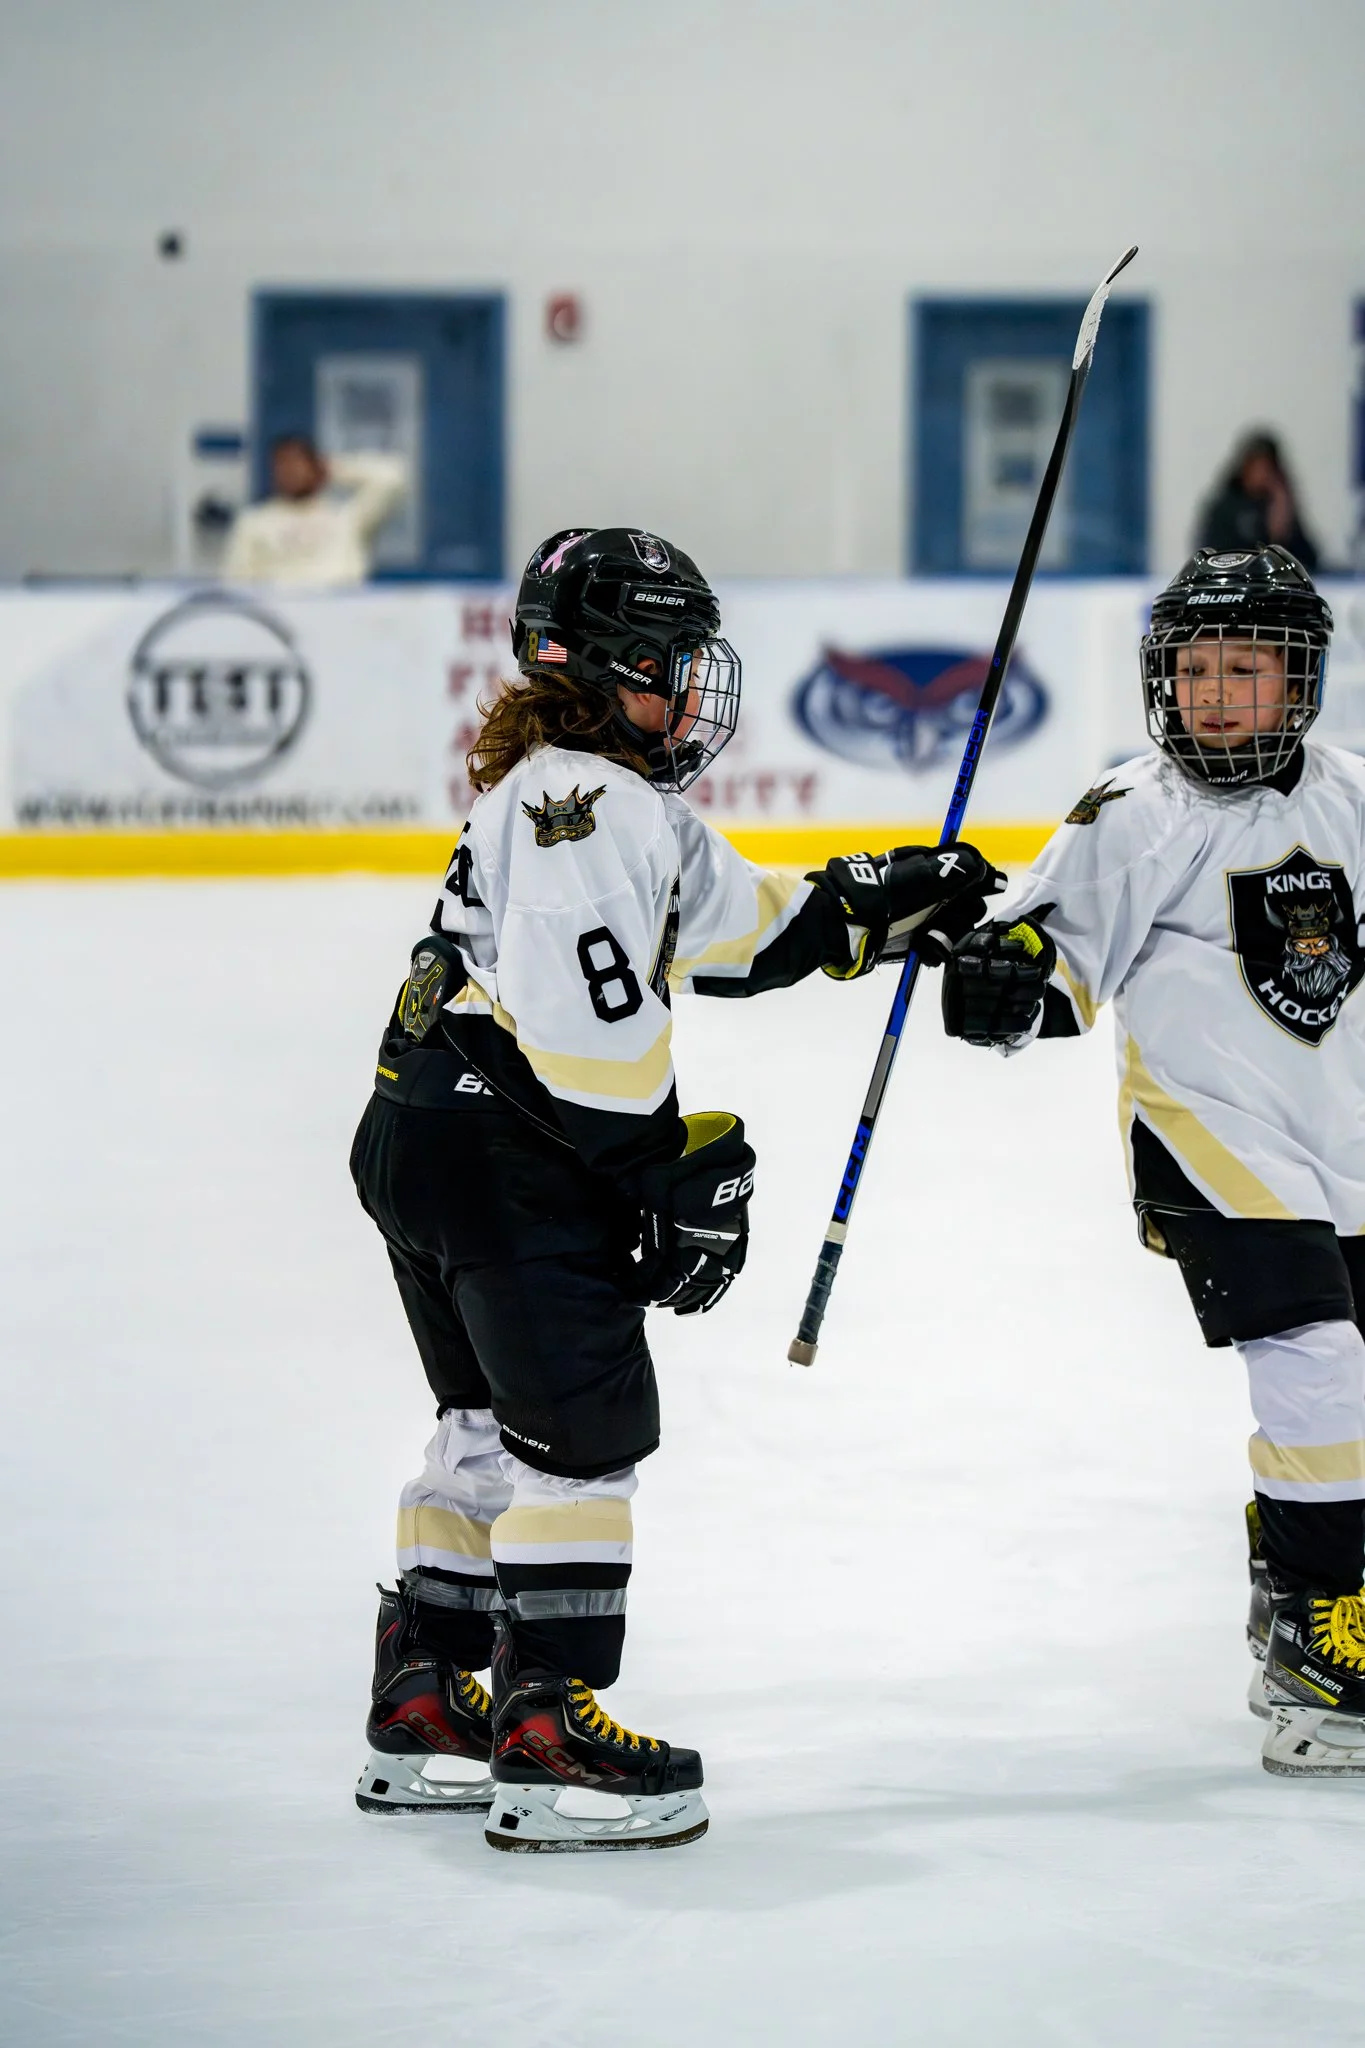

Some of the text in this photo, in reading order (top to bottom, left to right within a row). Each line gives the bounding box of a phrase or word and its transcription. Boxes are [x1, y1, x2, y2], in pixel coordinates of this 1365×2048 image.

[633, 592, 686, 607] BAUER
[1186, 593, 1246, 606] BAUER
[528, 631, 539, 663] 8
[950, 708, 989, 813] RIBCOR
[1265, 871, 1333, 895] KINGS
[576, 925, 645, 1024] 8
[833, 1122, 873, 1220] CCM
[502, 1423, 551, 1453] BAUER
[1300, 1664, 1344, 1695] BAUER
[407, 1711, 461, 1751] CCM
[521, 1729, 604, 1786] CCM
